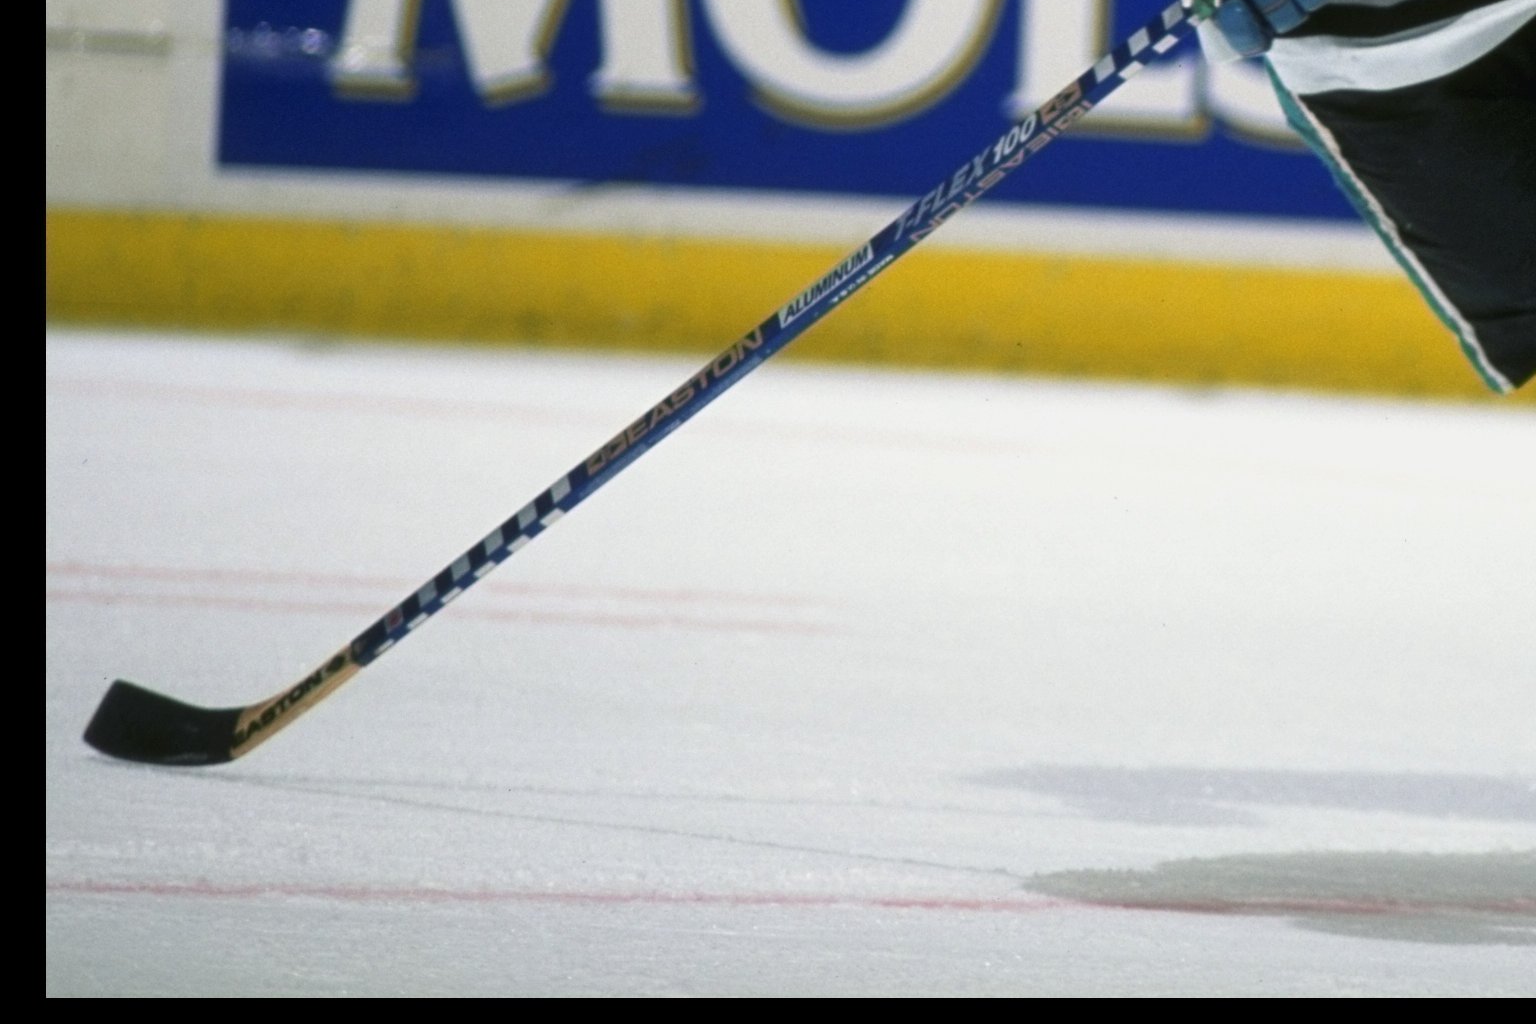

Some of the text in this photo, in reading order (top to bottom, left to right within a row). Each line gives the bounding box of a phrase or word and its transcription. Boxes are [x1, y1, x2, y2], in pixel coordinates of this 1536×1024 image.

[624, 326, 764, 446] EASTON
[782, 245, 871, 324] ALUMINUM
[992, 113, 1038, 164] 100
